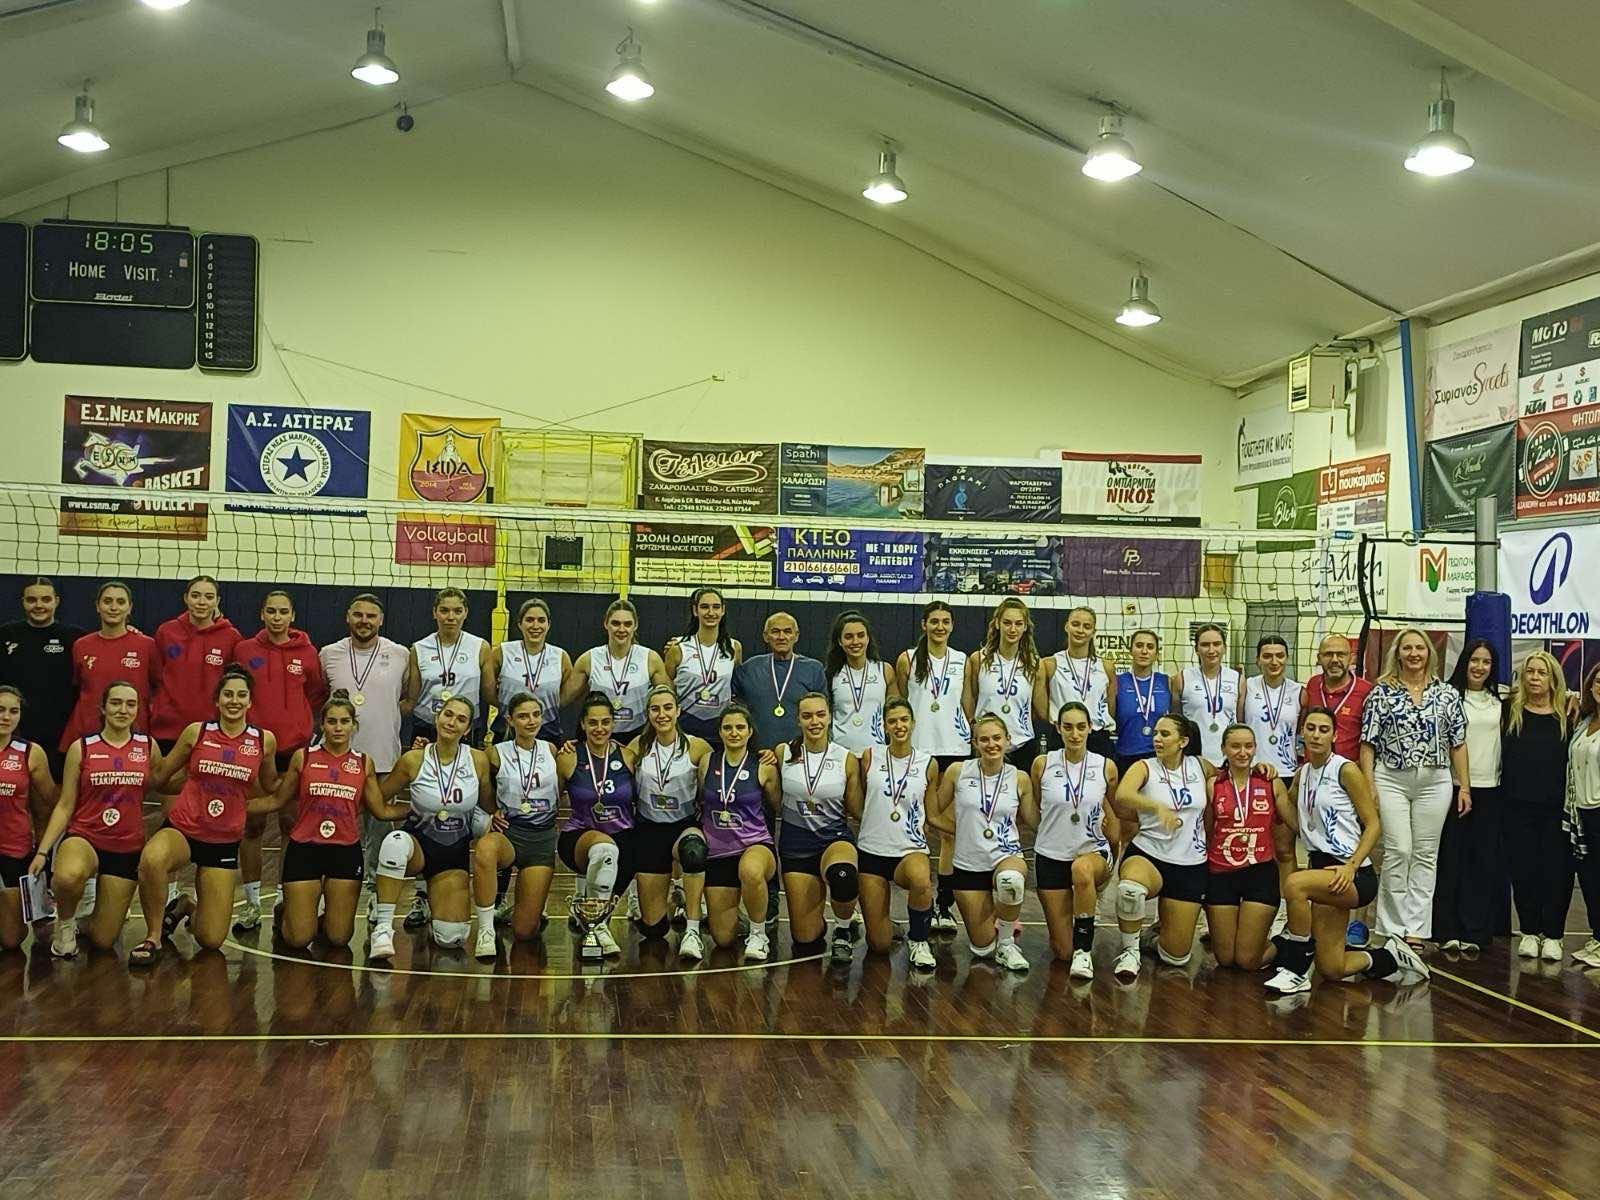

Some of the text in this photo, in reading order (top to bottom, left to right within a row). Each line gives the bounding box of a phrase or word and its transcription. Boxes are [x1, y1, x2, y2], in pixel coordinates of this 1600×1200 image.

[85, 231, 153, 254] 18:05
[69, 261, 107, 279] HOME
[206, 292, 213, 300] 9
[205, 322, 214, 330] 12
[1524, 398, 1547, 416] KTM
[246, 411, 354, 432] Α.Σ. ΑΣΤΕΡΑΣ
[145, 467, 205, 490] BASKET
[1106, 488, 1154, 504] ΝΙΚΟΣ
[404, 526, 488, 545] Volleyball
[636, 534, 714, 544] ΣΧΟΛΗ ΟΔΗΓΩΝ
[795, 529, 850, 546] ΚΤΕΟ
[425, 546, 466, 563] Team
[787, 547, 857, 560] ΠΑΛΛΗΝΗΣ
[865, 543, 879, 553] ΜΕ
[785, 562, 805, 572] 210
[1511, 612, 1590, 634] DECATHLON
